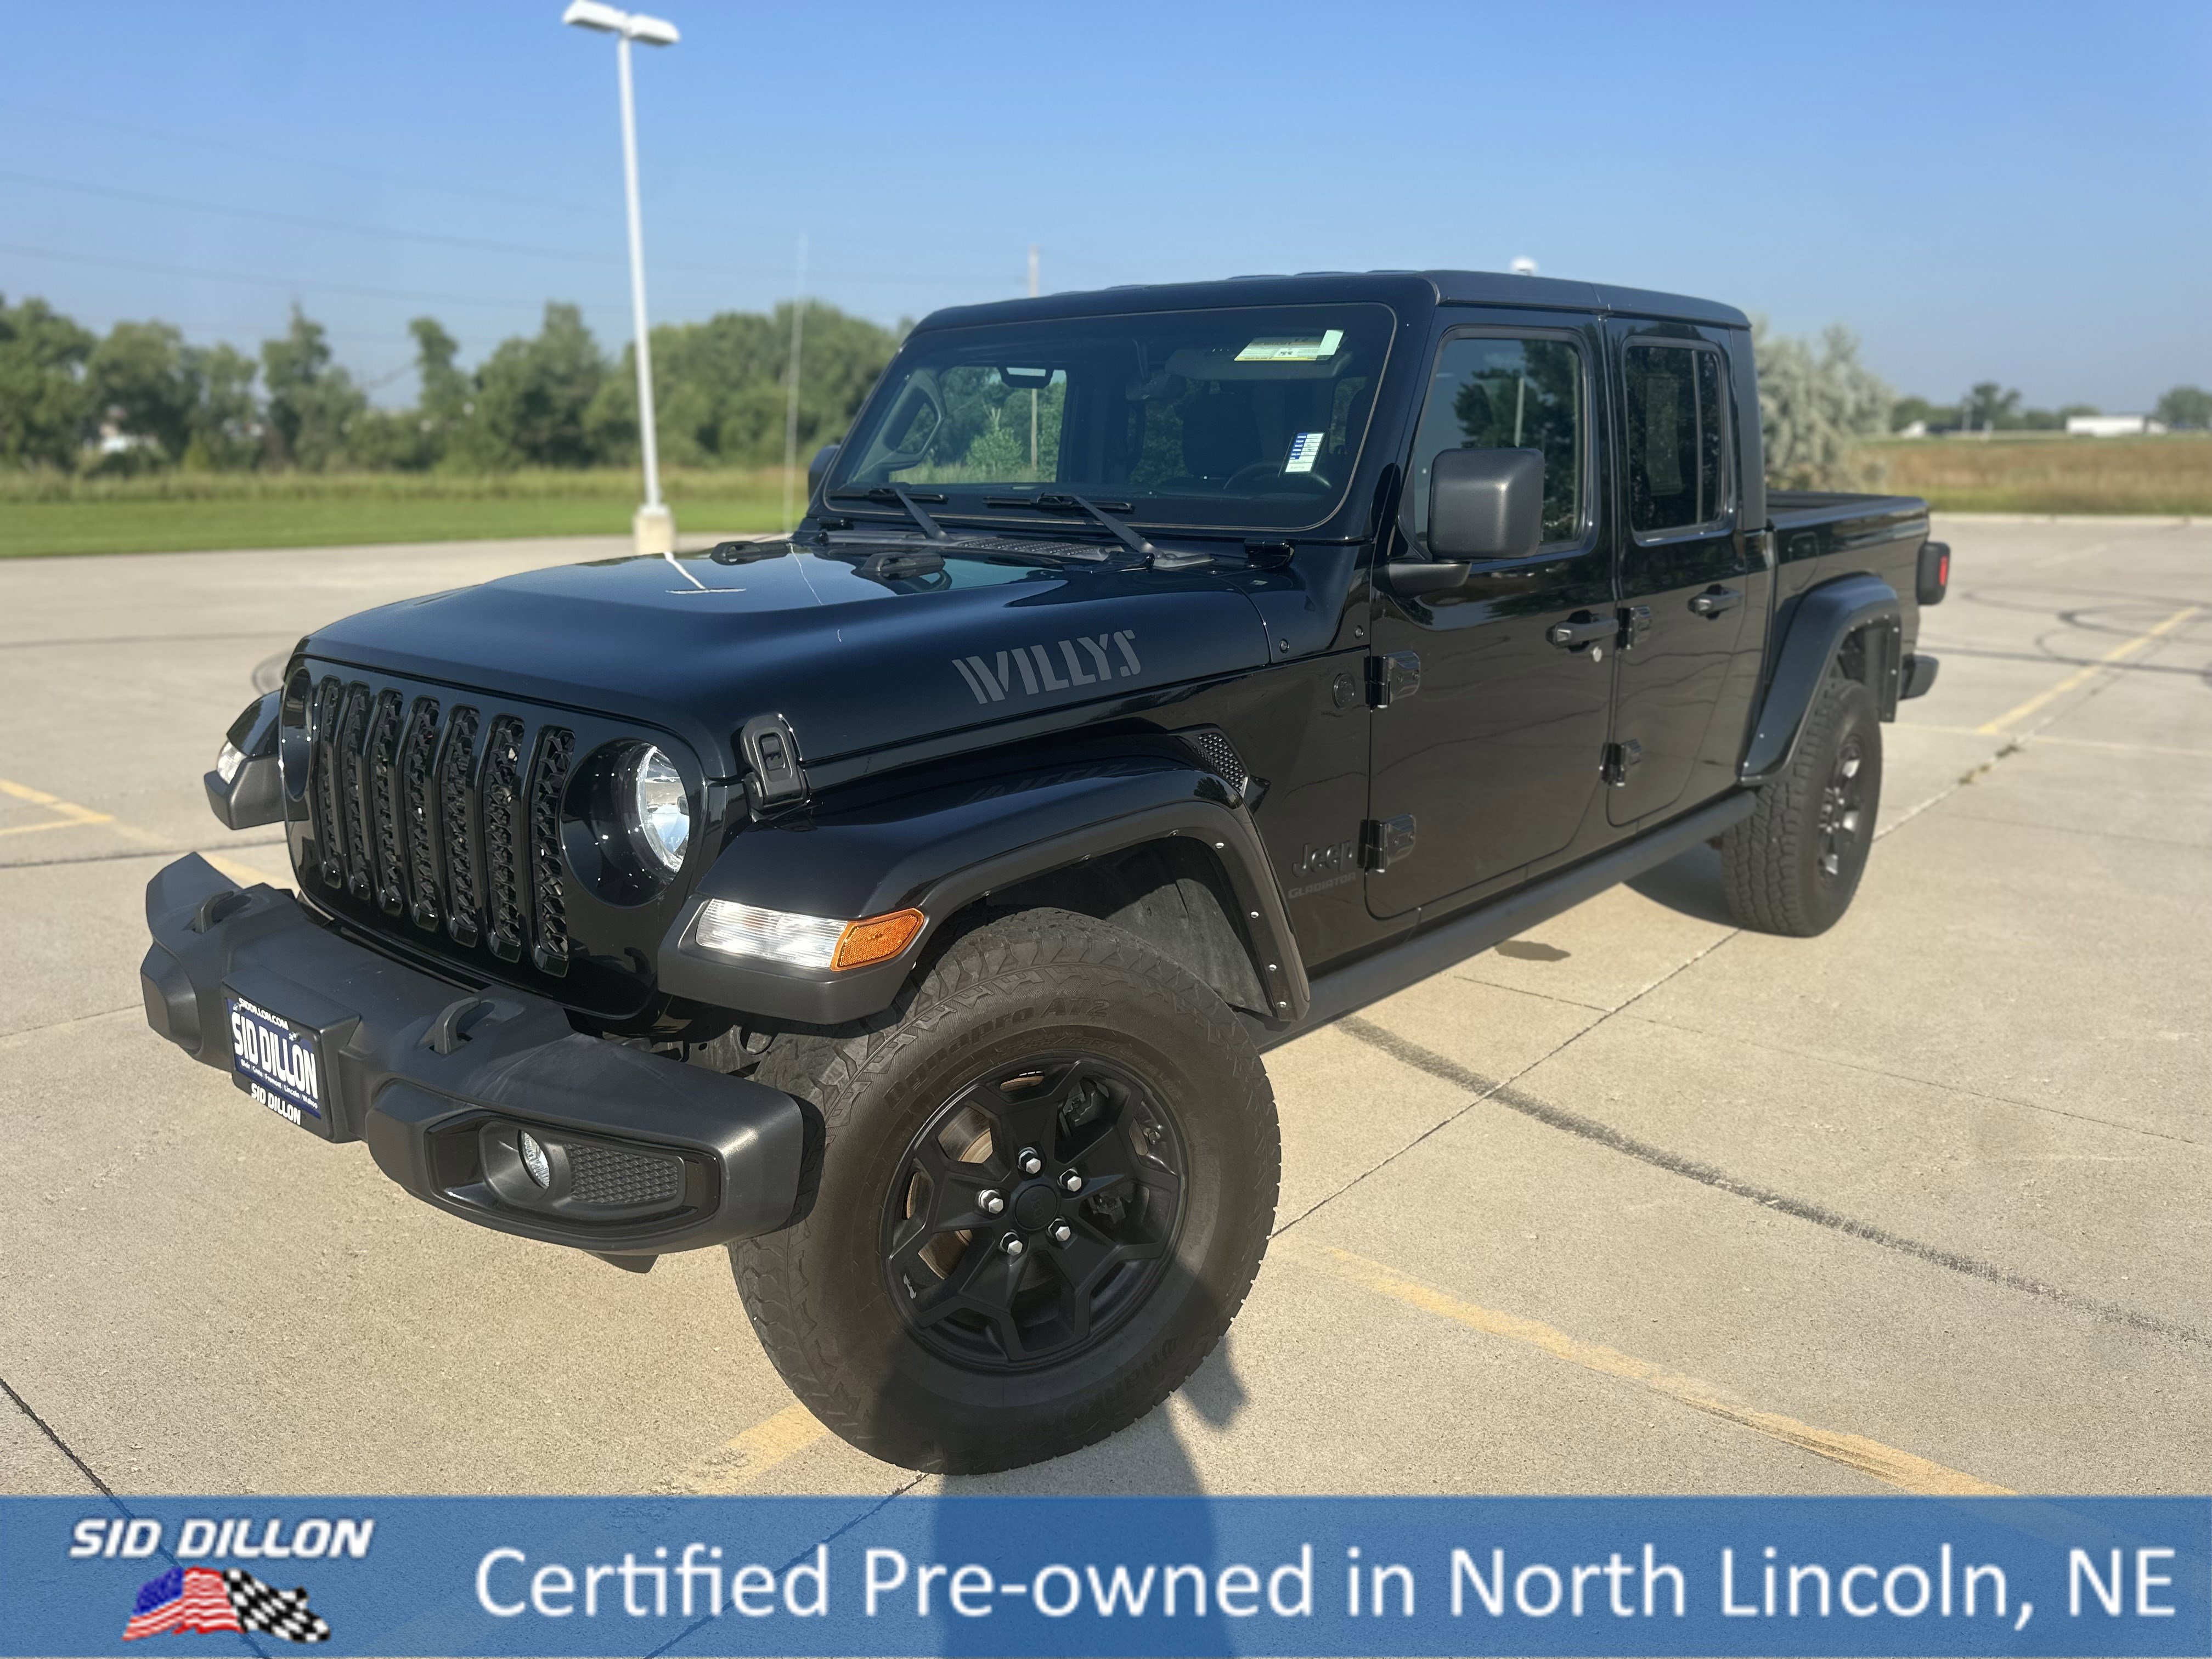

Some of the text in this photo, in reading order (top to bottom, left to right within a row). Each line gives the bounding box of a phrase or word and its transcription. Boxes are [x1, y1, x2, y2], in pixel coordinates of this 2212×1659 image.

[952, 629, 1141, 704] WILLYS
[1292, 840, 1353, 878] Jeep
[1288, 872, 1357, 899] GLADIATOR
[238, 997, 289, 1031] SIDDILLON.COM
[232, 1012, 318, 1099] SID DILLON
[883, 1006, 1035, 1111] Dynapro
[251, 1082, 301, 1125] SID DILLON
